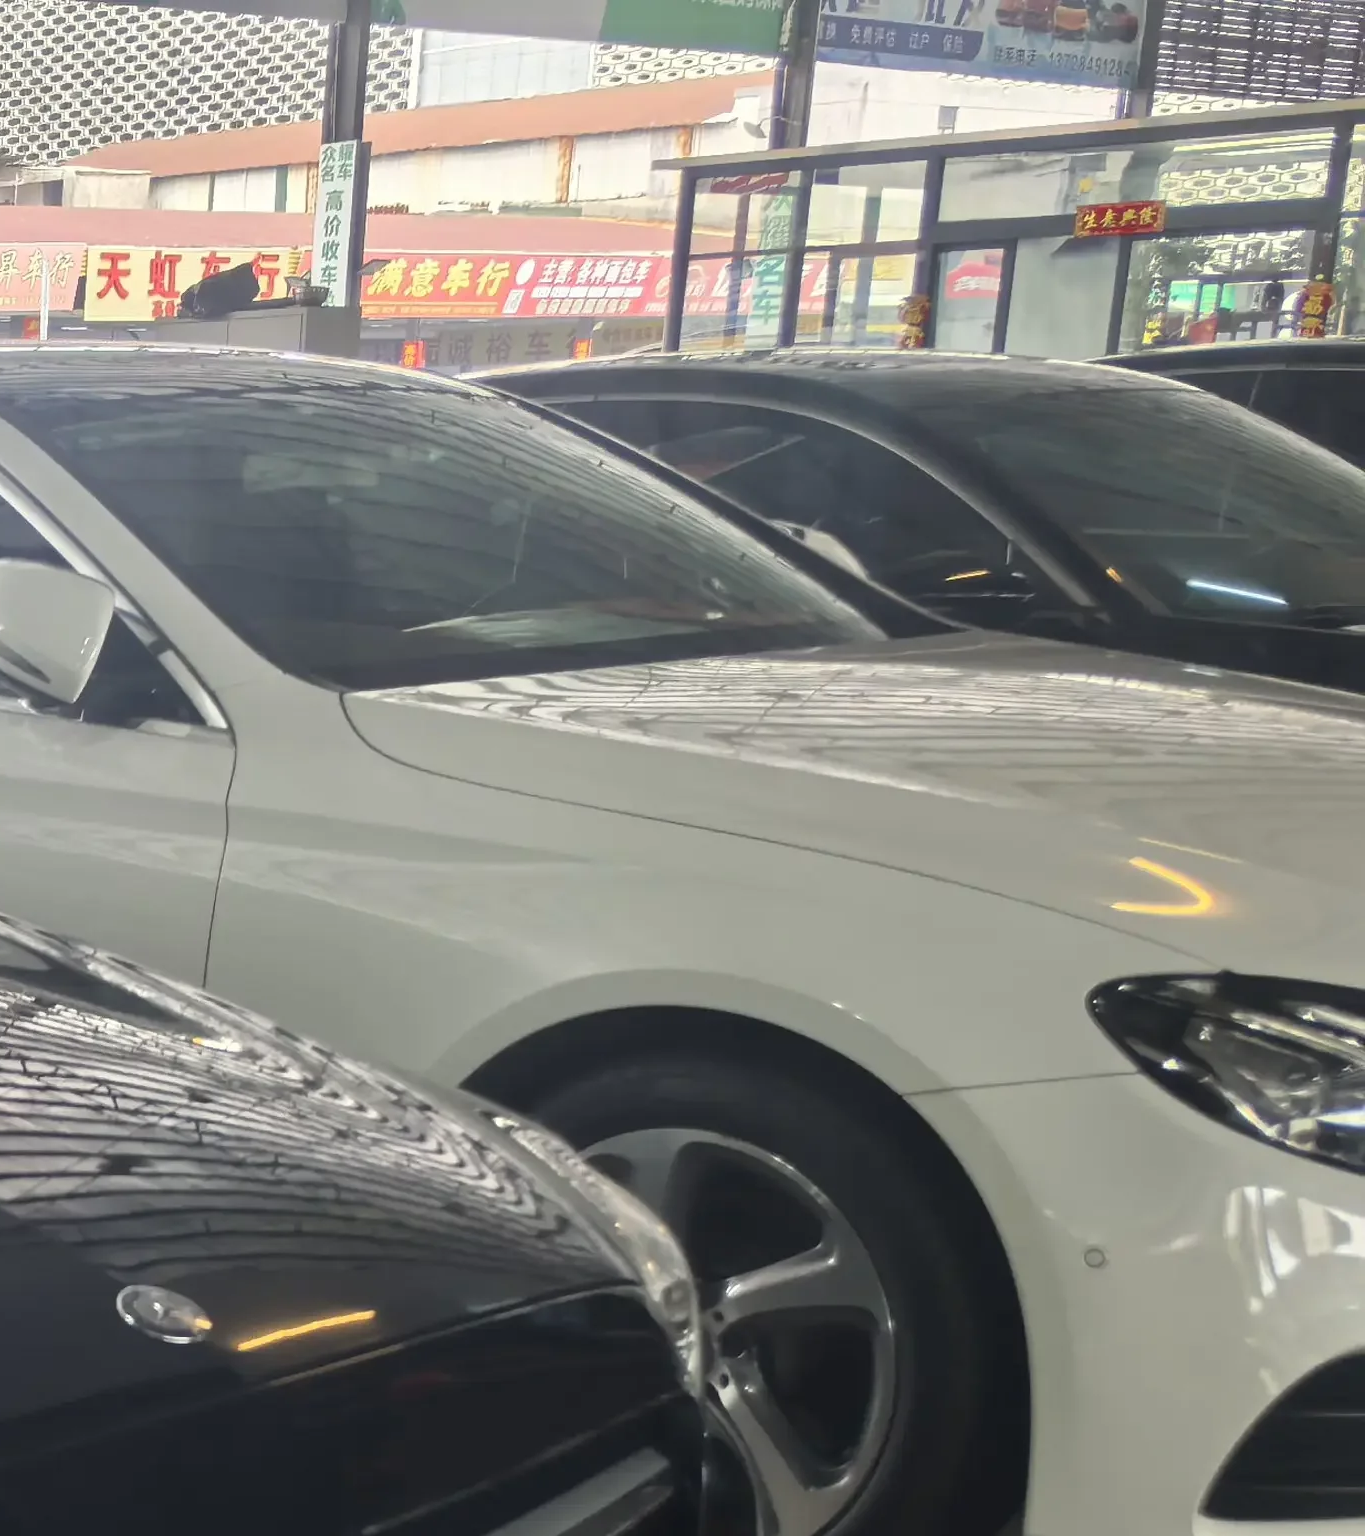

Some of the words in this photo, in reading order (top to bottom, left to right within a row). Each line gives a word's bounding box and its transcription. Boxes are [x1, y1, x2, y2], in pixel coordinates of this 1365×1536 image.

[850, 24, 897, 47] 免费评估
[909, 32, 930, 49] 过户
[942, 34, 964, 53] 保险
[367, 258, 511, 298] 满意车行
